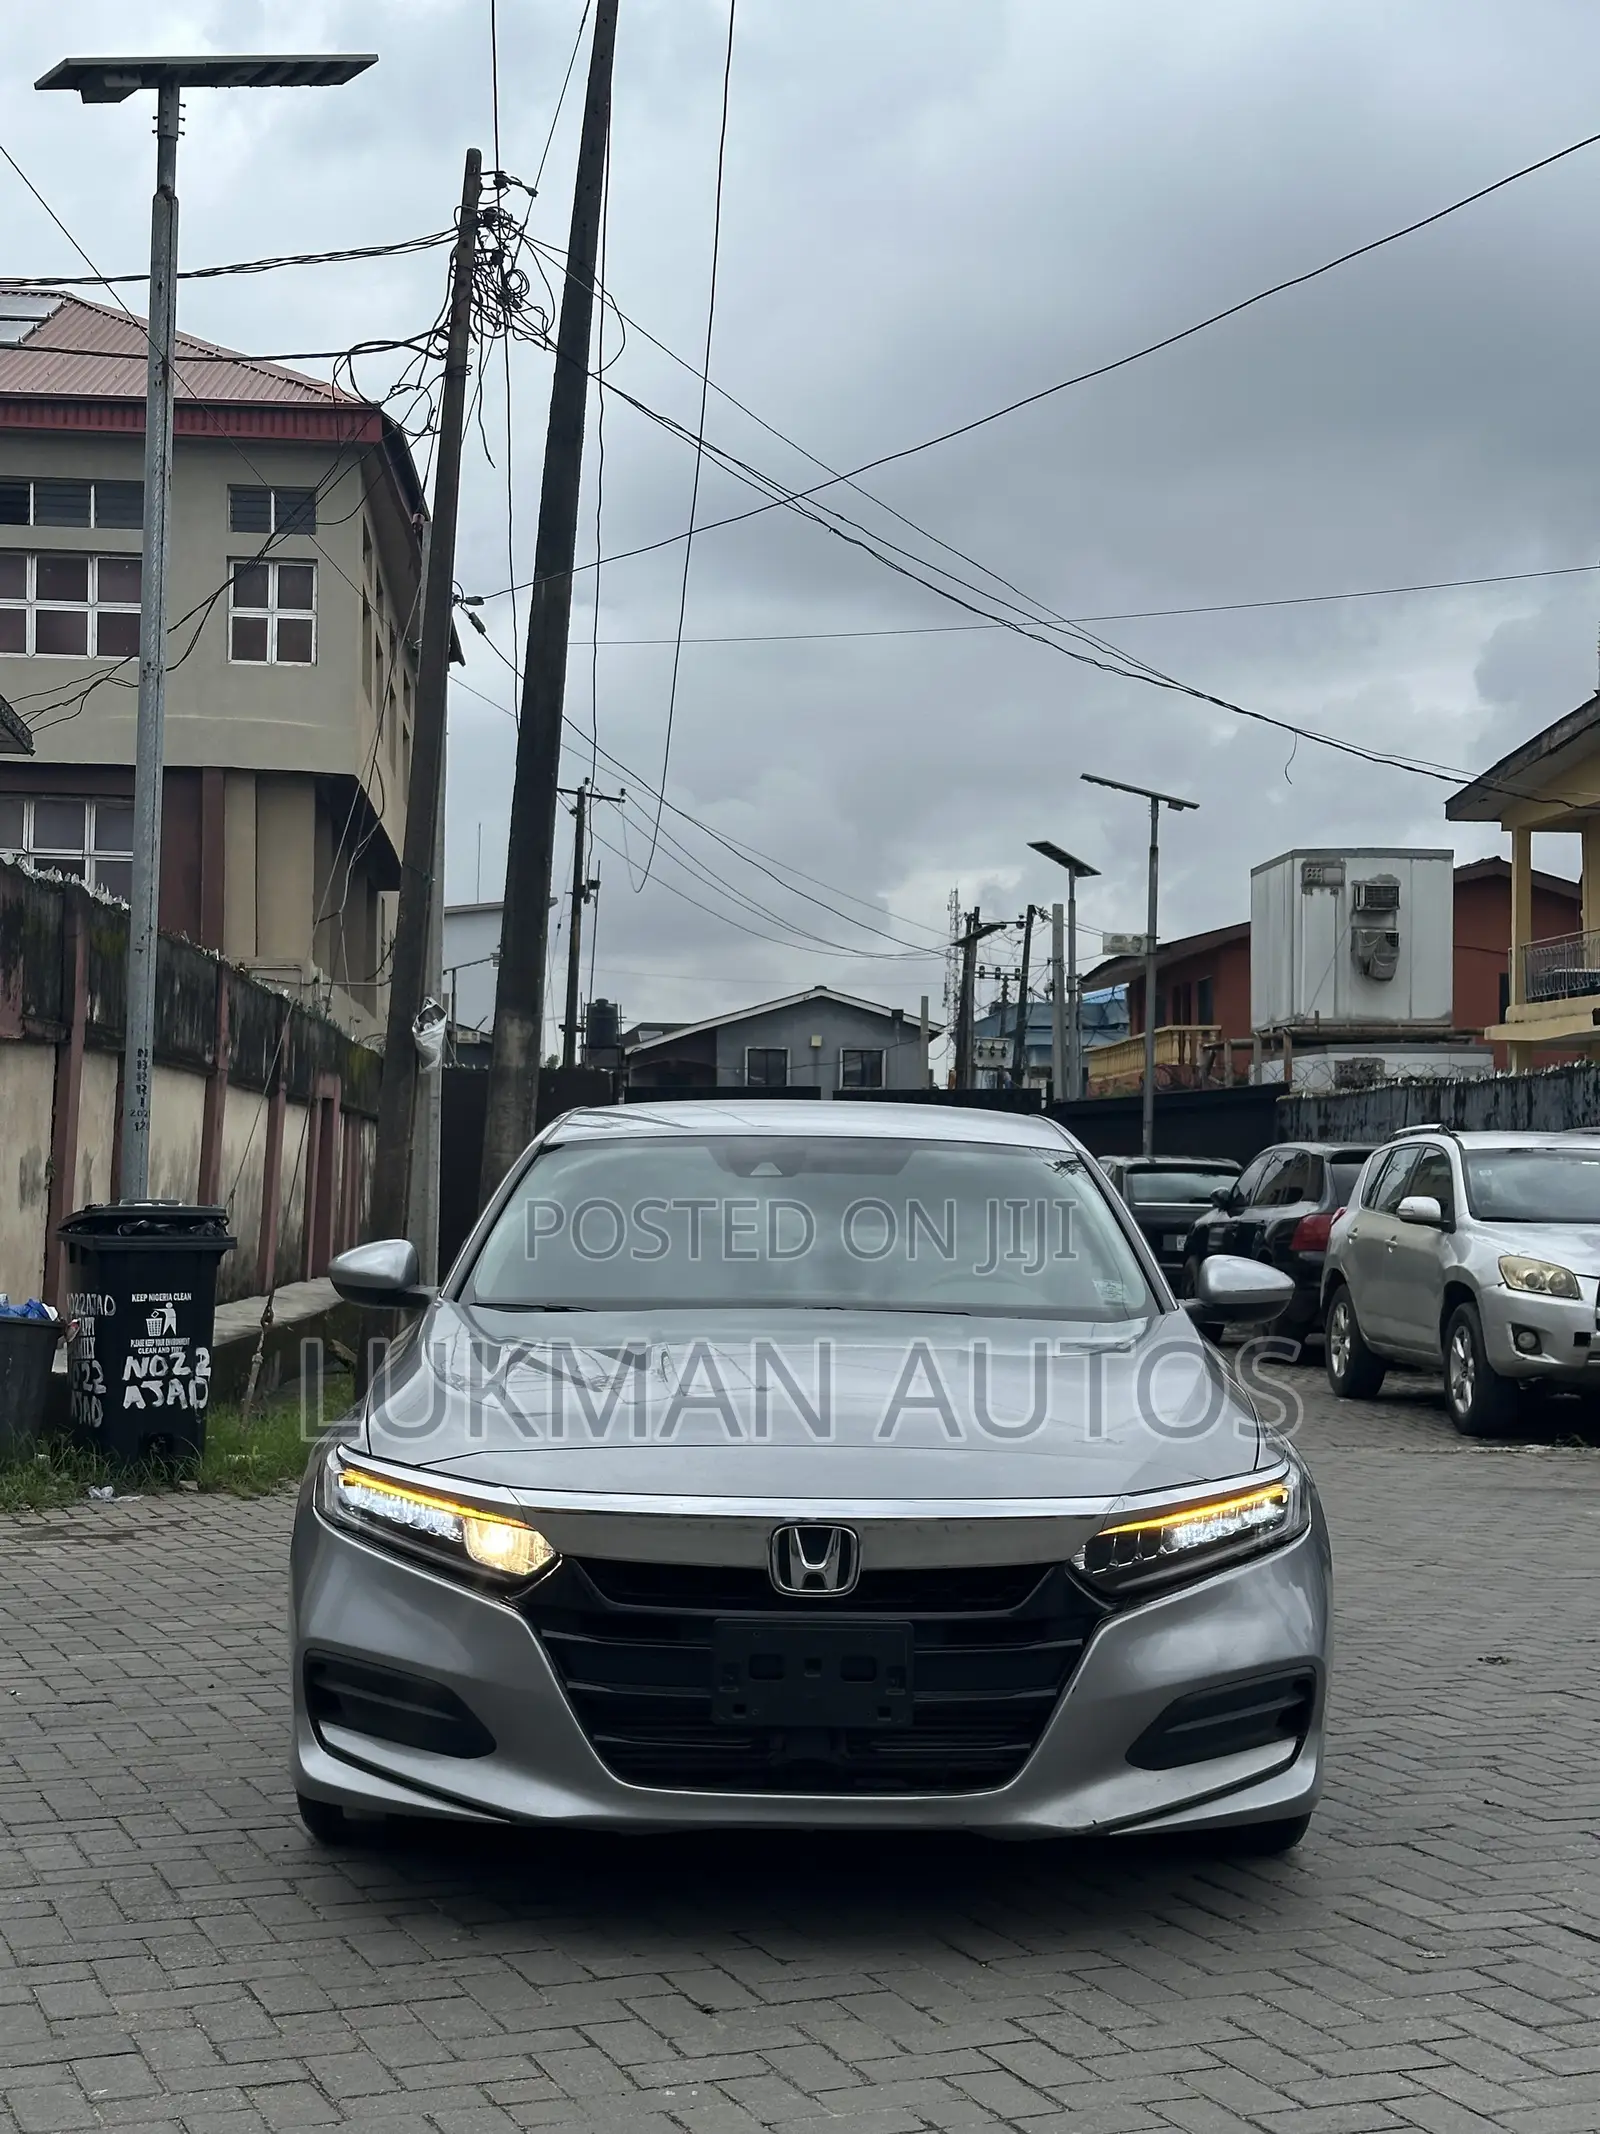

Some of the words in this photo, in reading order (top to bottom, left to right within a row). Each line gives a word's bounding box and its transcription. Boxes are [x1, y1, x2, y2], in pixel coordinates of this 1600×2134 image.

[131, 1293, 148, 1302] KEEP
[148, 1292, 173, 1302] NIGERIA
[173, 1292, 192, 1301] CLEAN
[137, 1347, 157, 1355] CLEAN
[157, 1346, 170, 1354] AND
[123, 1376, 209, 1410] AJAD
